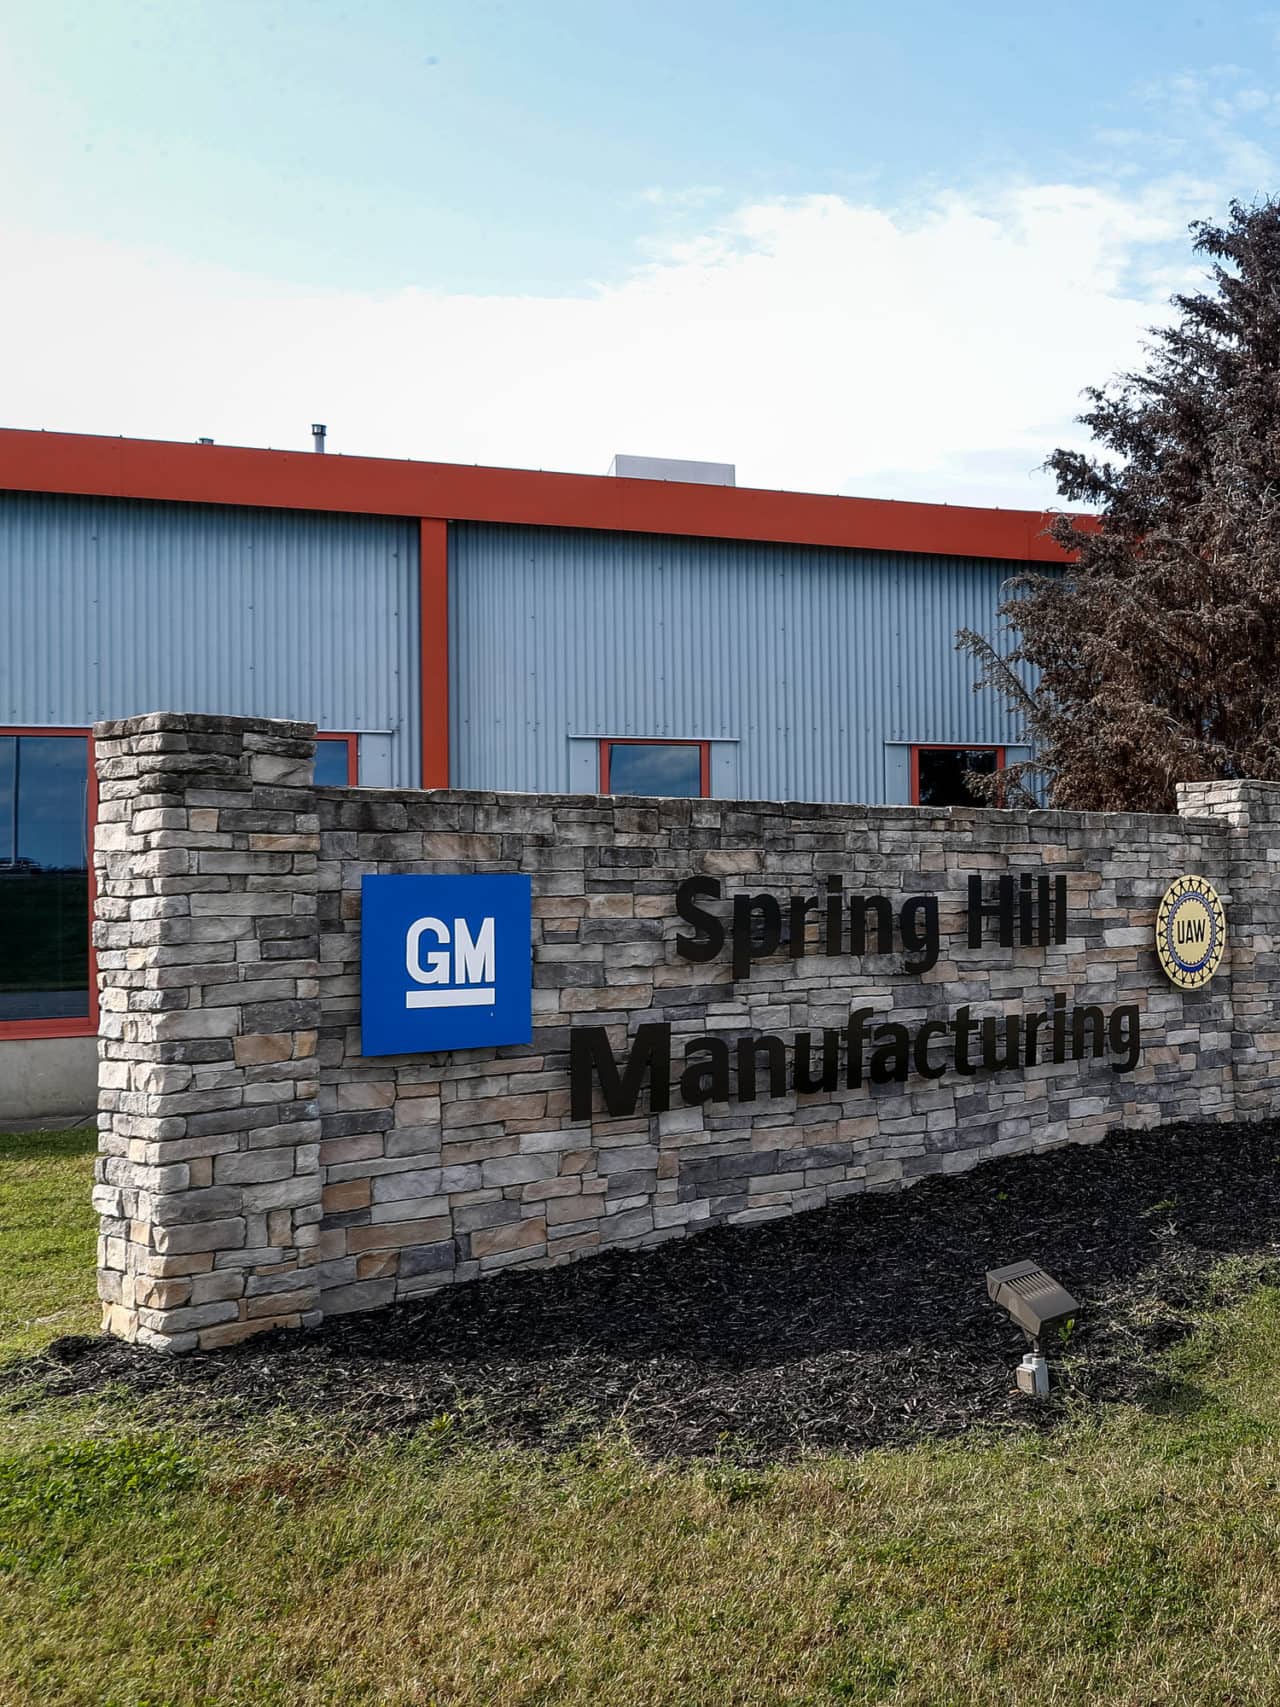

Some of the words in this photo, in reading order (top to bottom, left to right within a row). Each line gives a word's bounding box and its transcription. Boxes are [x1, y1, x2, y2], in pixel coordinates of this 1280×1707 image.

[406, 917, 495, 984] GM
[676, 875, 939, 979] Spring
[967, 875, 1066, 949] Hill
[1177, 919, 1206, 944] UAW
[570, 993, 1140, 1121] Manufacturing
